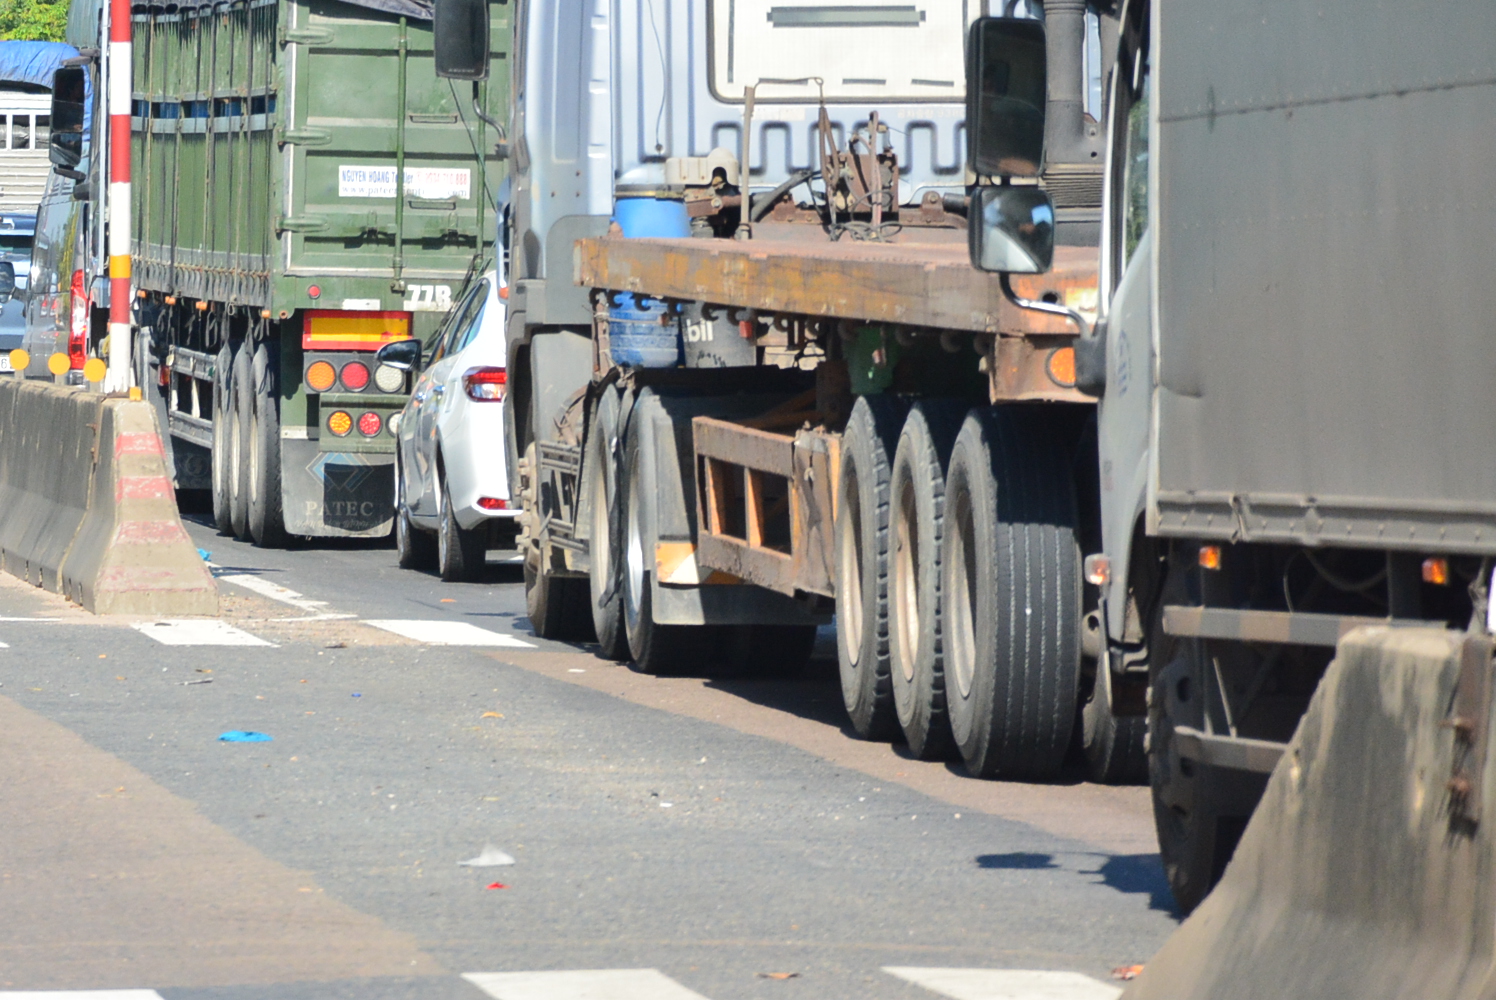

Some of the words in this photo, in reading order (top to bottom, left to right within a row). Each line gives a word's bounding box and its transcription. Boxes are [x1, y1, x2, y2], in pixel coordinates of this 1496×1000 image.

[407, 284, 452, 308] 77R
[684, 318, 713, 342] bil
[305, 500, 374, 516] PATEC
